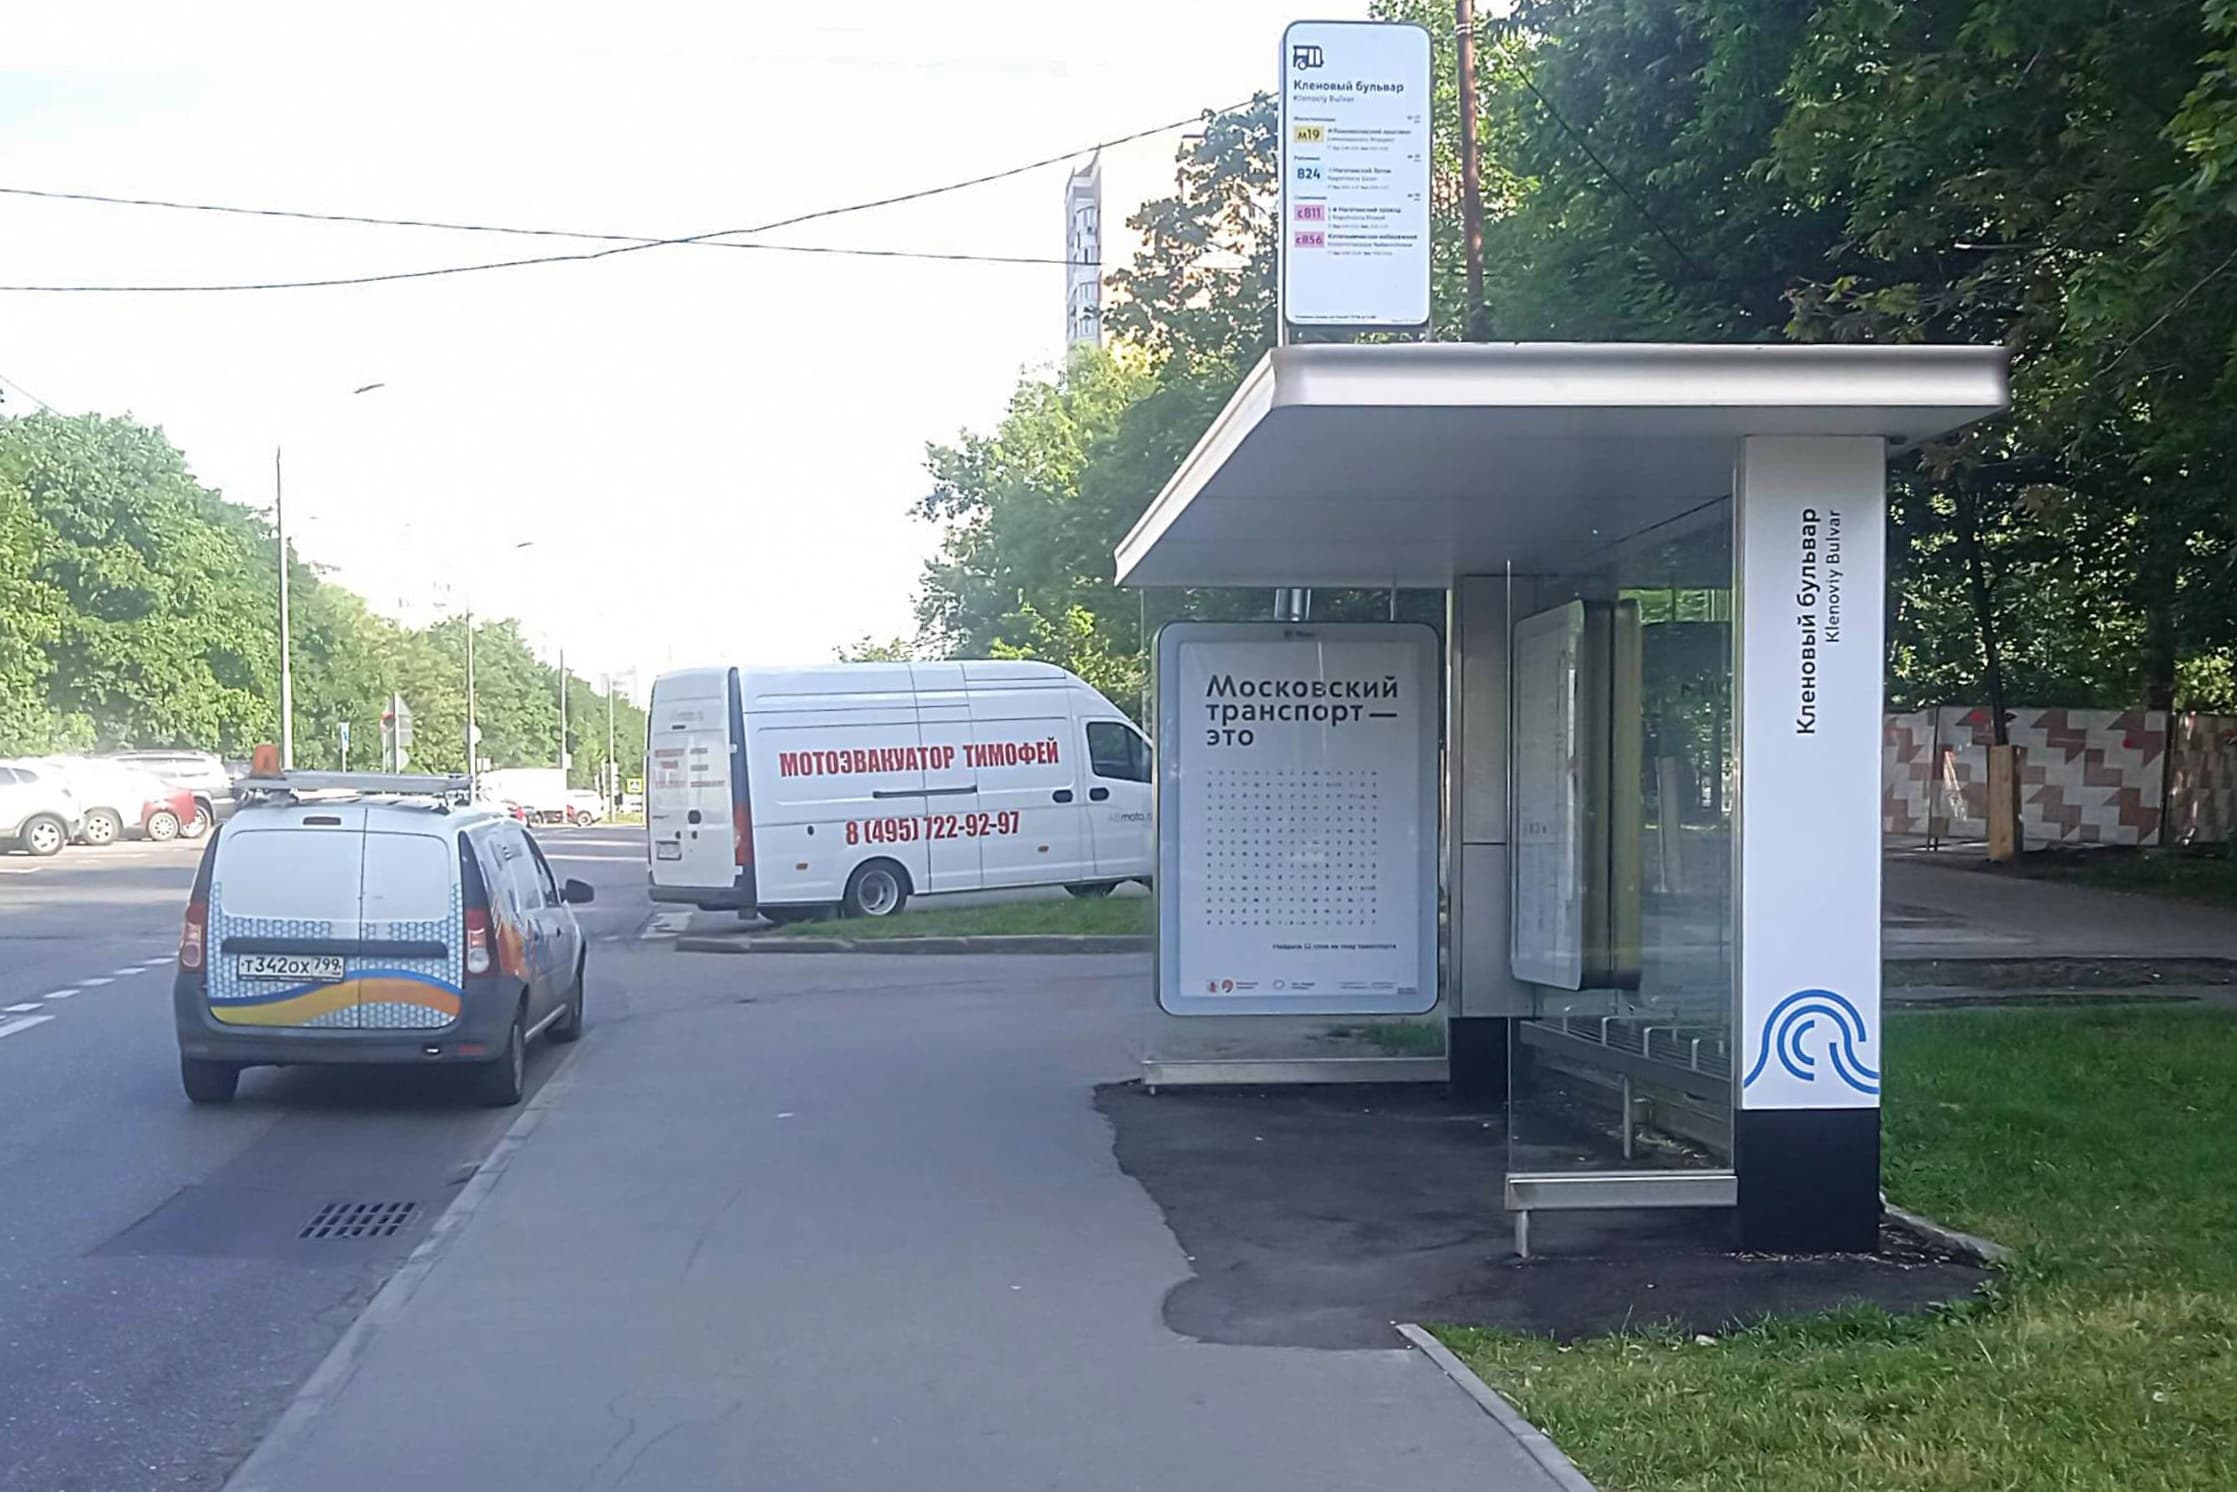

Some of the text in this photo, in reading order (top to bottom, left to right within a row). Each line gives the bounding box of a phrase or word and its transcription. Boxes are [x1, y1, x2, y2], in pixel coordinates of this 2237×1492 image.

[1293, 79, 1404, 94] Кленовый бульвар
[1297, 167, 1321, 180] 824
[1825, 510, 1844, 643] Klenoviy Bulvar
[1796, 508, 1821, 735] Кленовый бульвар
[1206, 674, 1398, 699] Московский
[1206, 703, 1364, 727] транспорт
[1206, 729, 1255, 747] это
[779, 736, 1060, 777] МОТОЭВАКУАТОР ТИМОФЕЙ
[846, 811, 1020, 845] 8 (495) 722-92-97
